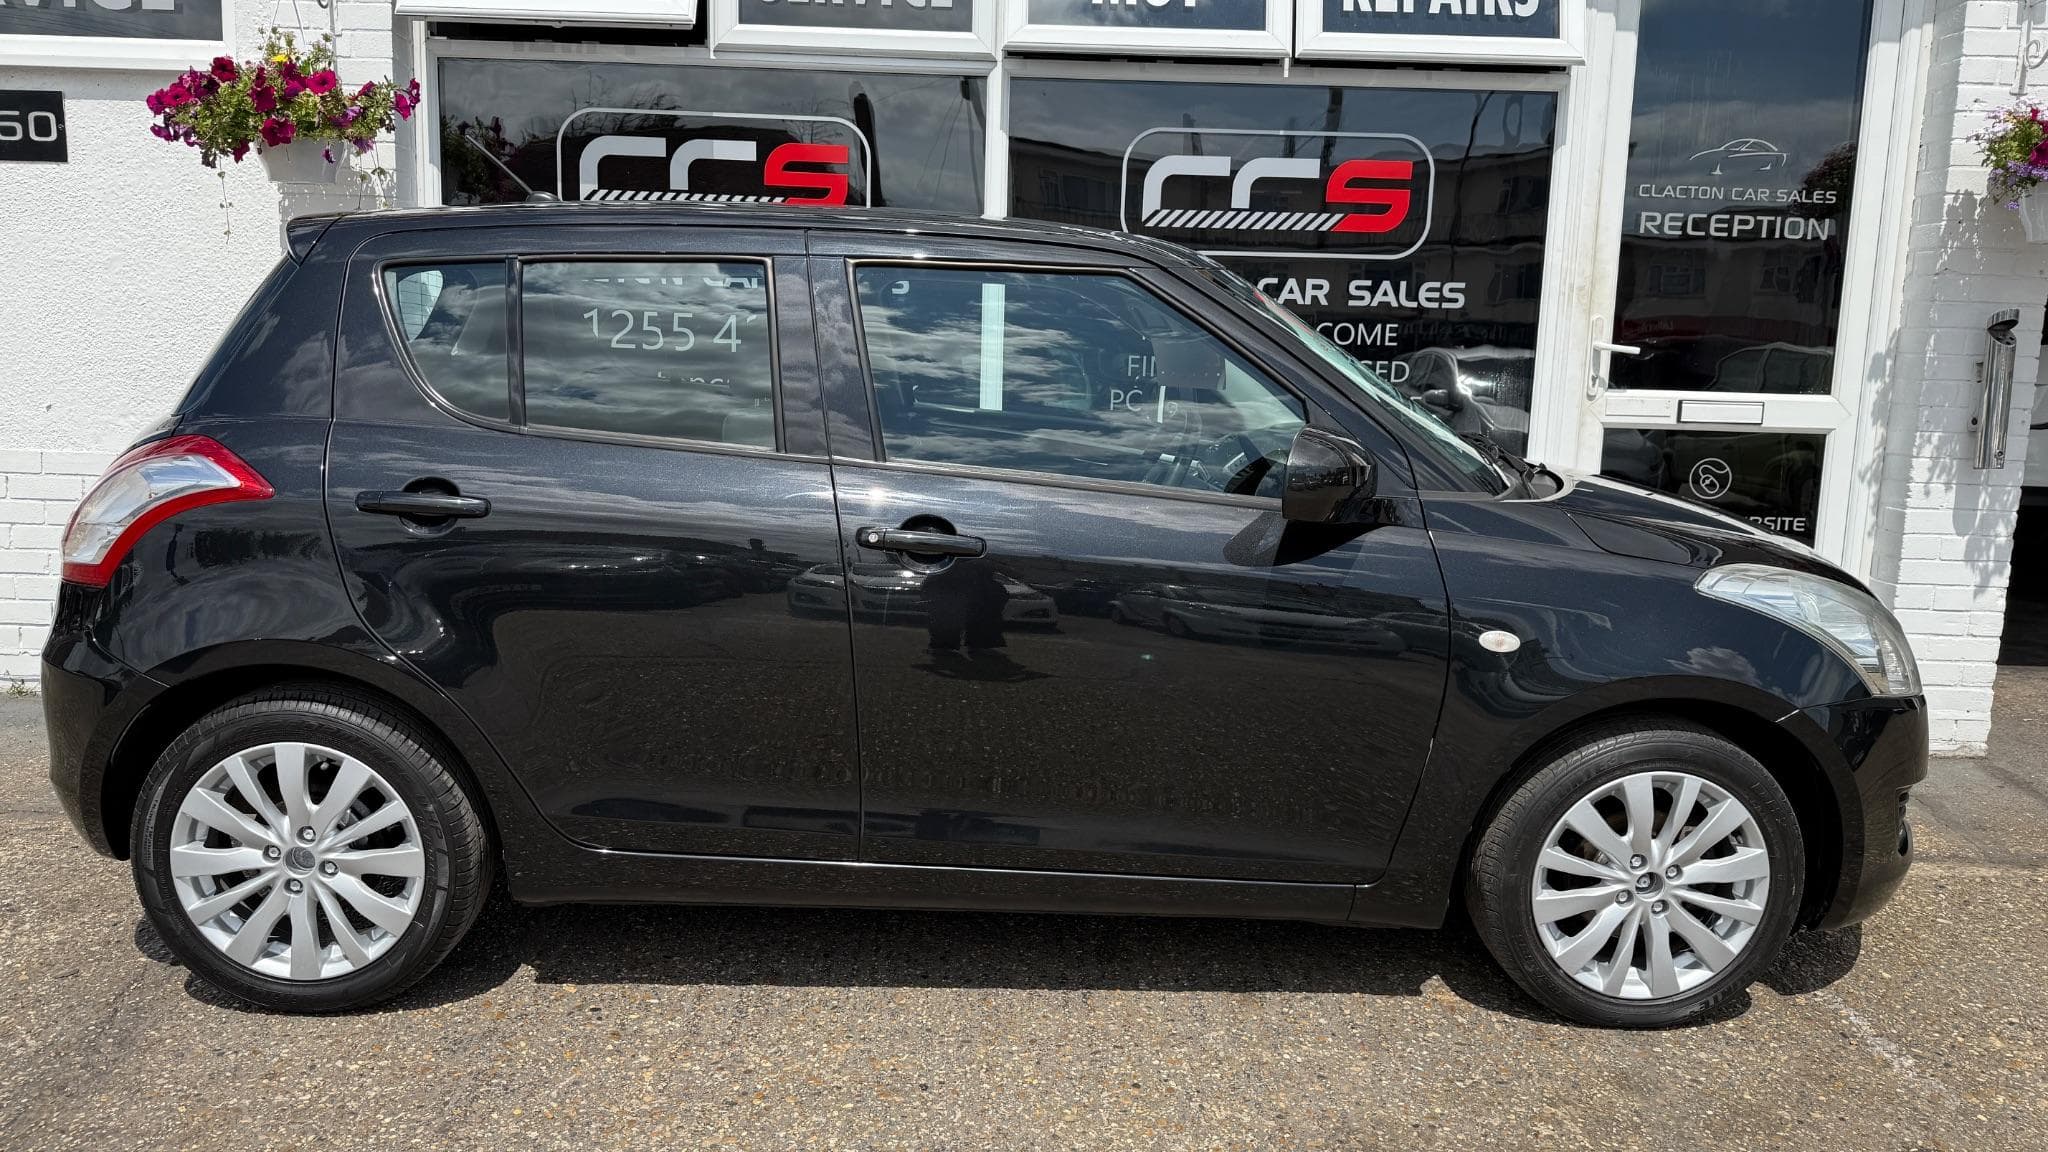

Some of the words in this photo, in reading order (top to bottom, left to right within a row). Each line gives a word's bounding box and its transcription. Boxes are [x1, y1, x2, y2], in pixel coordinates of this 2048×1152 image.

[1639, 184, 1724, 200] CLACTON
[1731, 187, 1770, 201] CAR
[1775, 189, 1838, 204] SALES
[1639, 211, 1830, 241] RECEPTION
[1348, 280, 1466, 309] SALES
